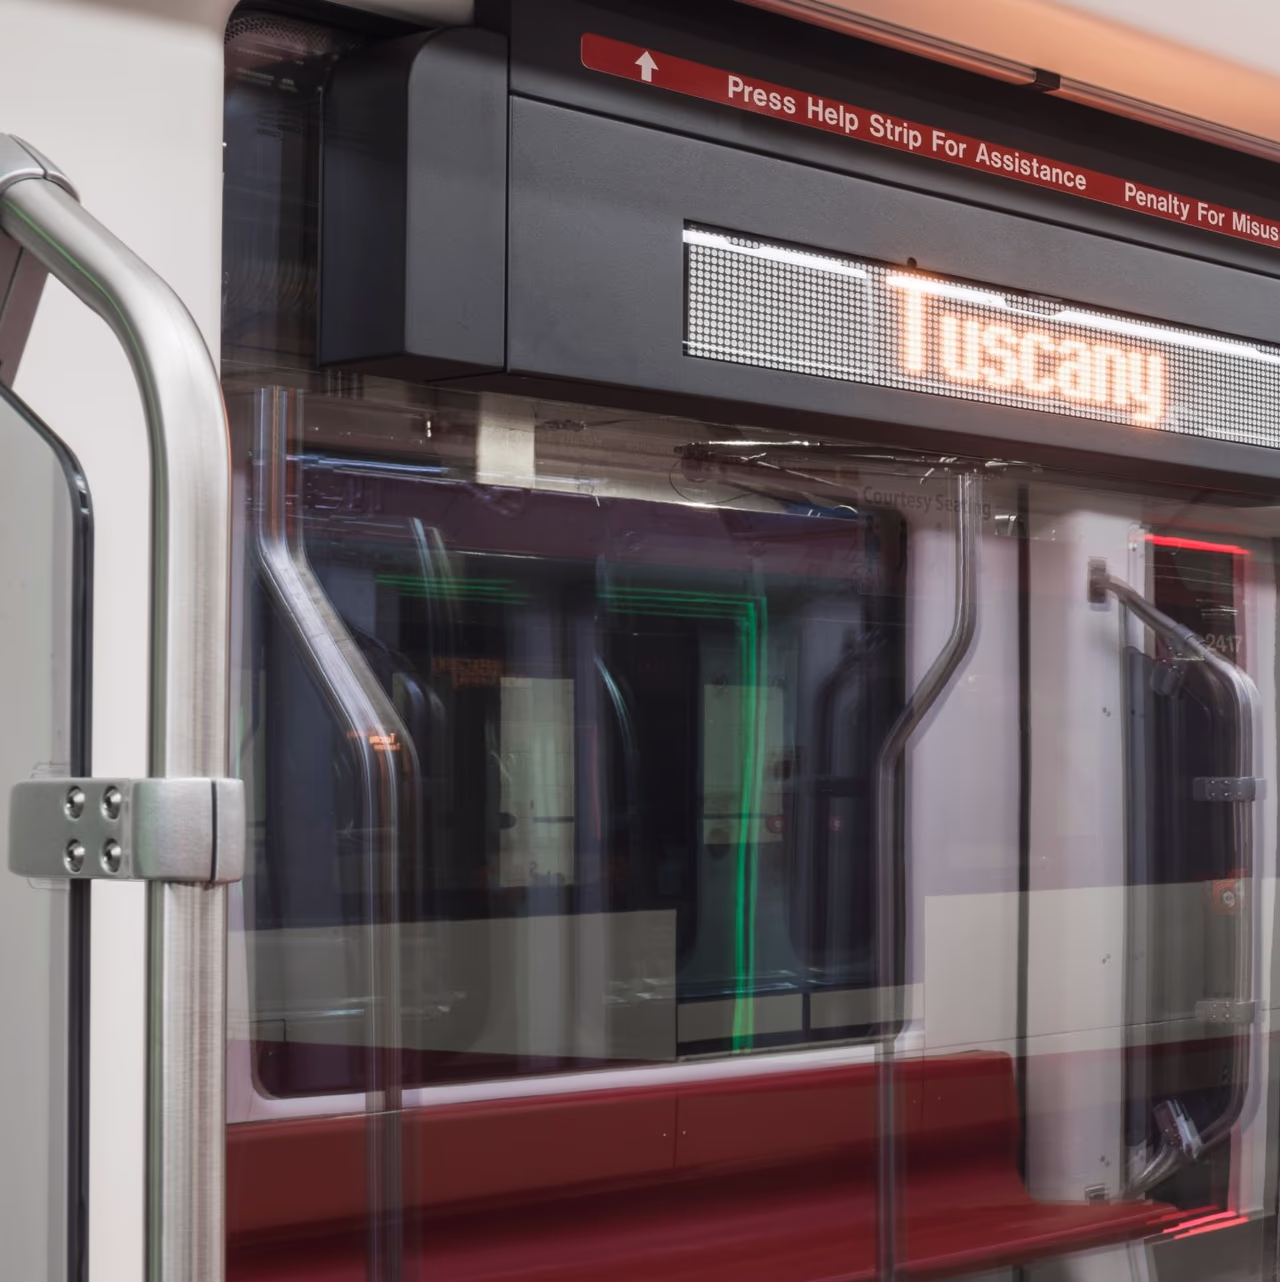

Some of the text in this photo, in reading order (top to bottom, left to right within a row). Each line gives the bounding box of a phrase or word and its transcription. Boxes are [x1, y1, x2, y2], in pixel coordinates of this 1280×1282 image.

[728, 75, 1087, 191] Press Help Strip For Assistance
[1124, 182, 1190, 221] Penalty
[1197, 201, 1225, 227] For
[889, 275, 1166, 426] Tuscany
[863, 485, 931, 514] Courtesy
